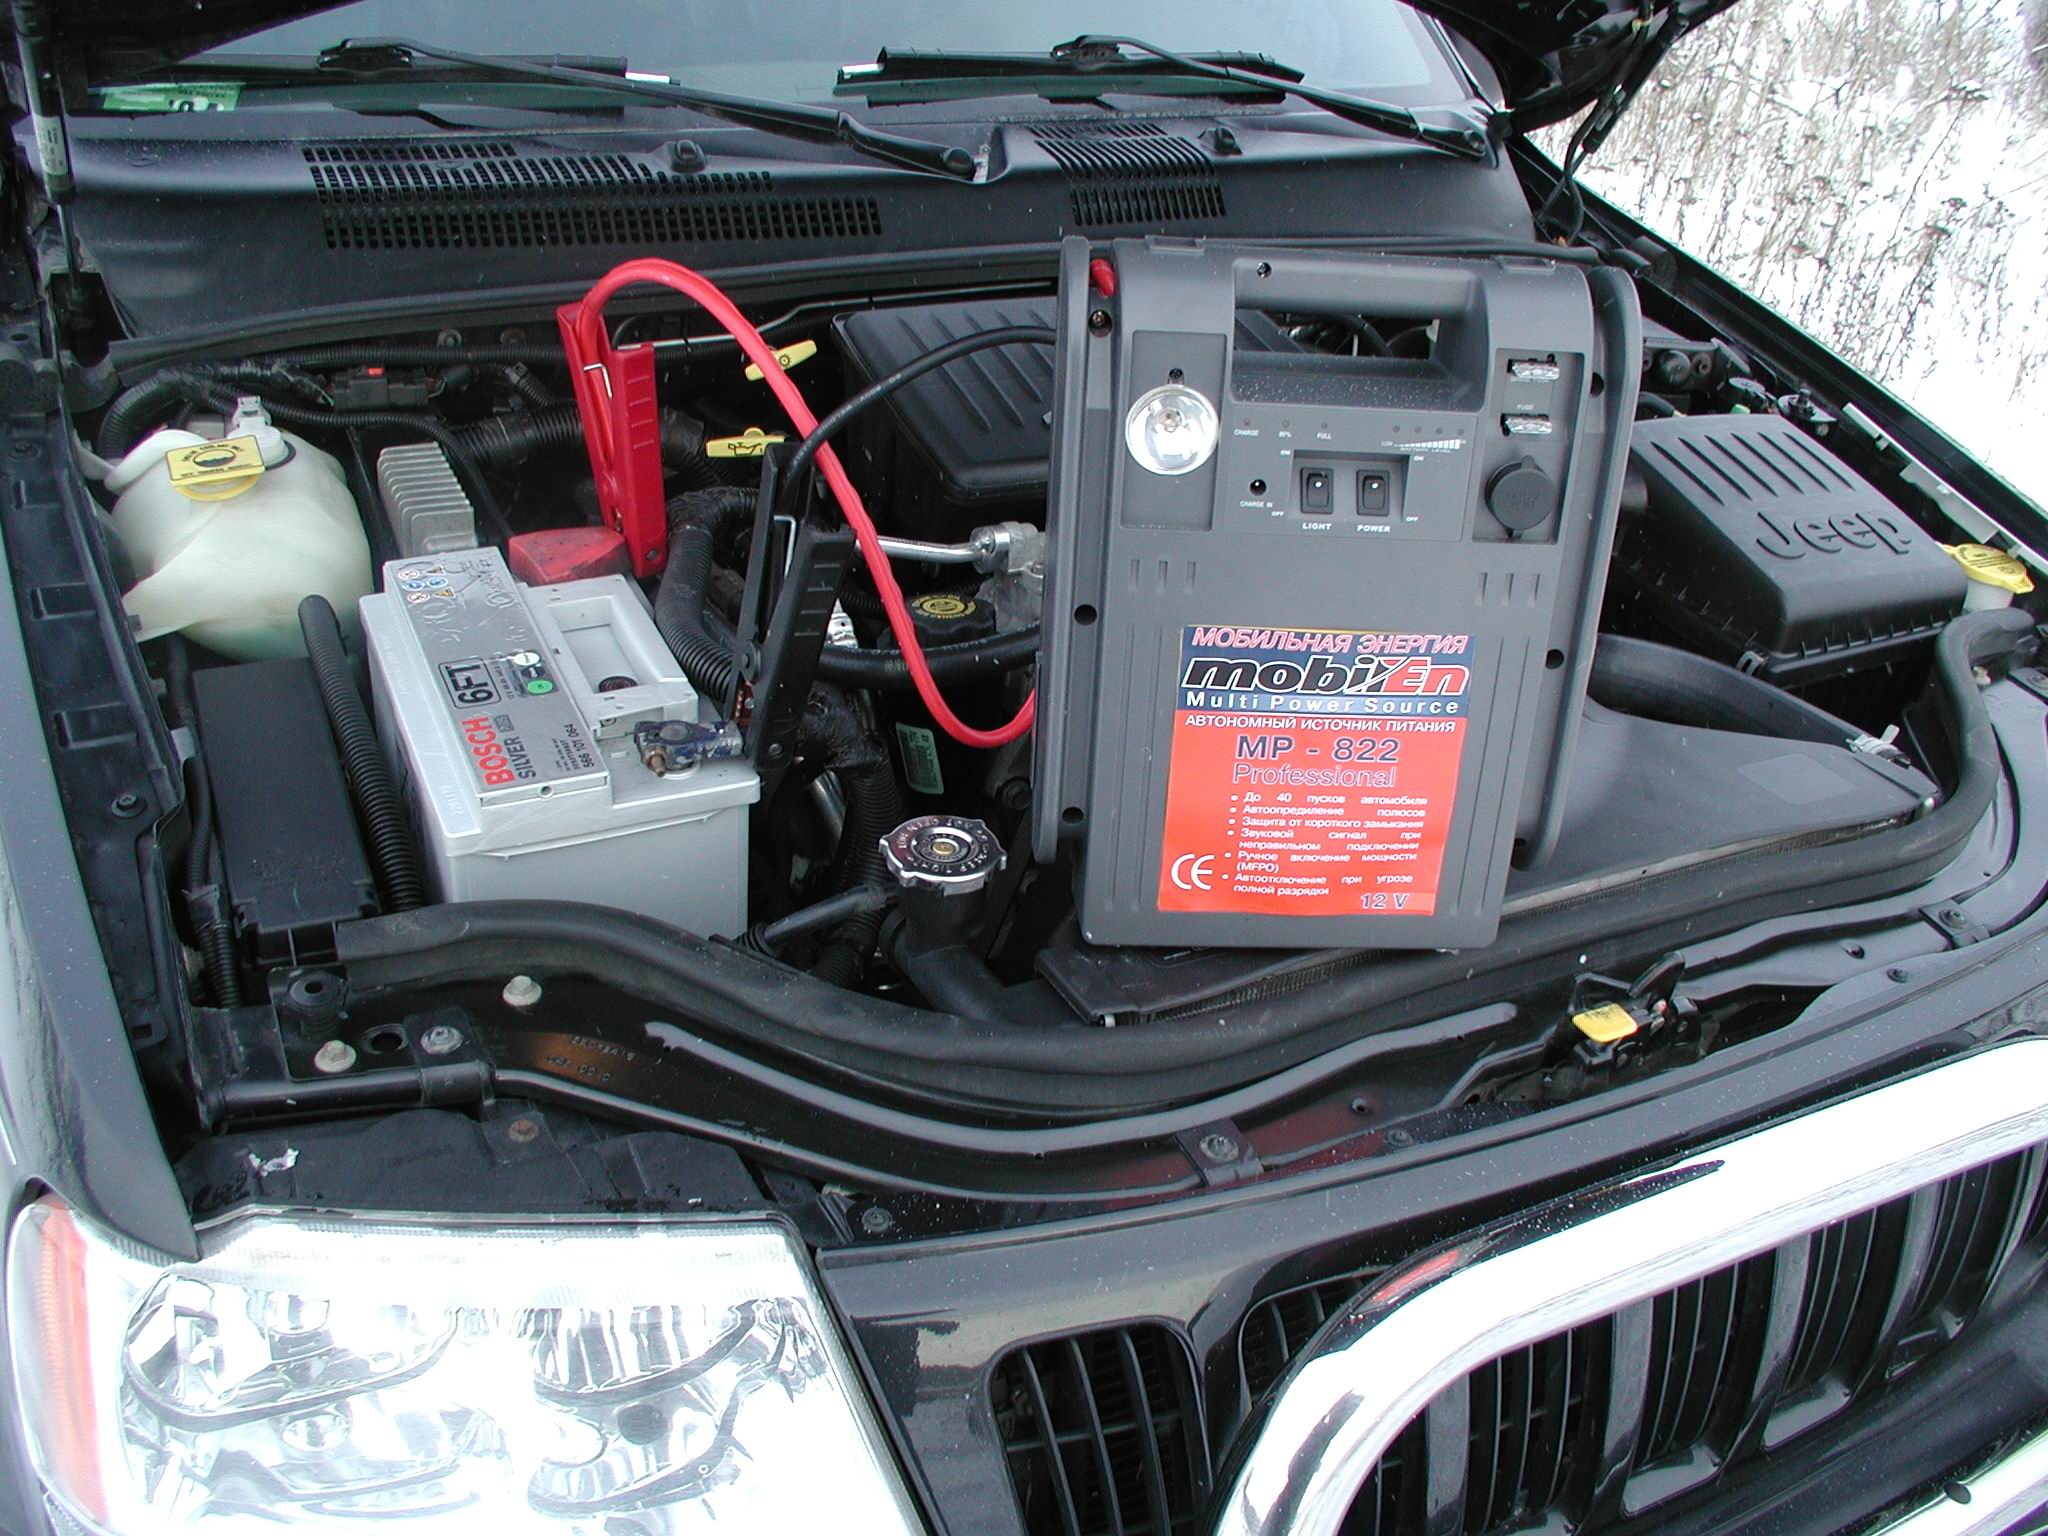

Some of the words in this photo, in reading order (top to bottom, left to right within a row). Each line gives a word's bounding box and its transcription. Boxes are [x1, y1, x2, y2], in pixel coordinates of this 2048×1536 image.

[1316, 432, 1332, 440] FULL
[1302, 522, 1332, 530] LIGHT
[1357, 524, 1391, 533] POWER
[1755, 510, 1913, 561] Jeep
[1191, 627, 1353, 654] МОБИЛЬНАЯ
[1356, 634, 1469, 654] ЭНЕРГИЯ
[1186, 692, 1258, 709] Multi
[1270, 695, 1352, 712] Power
[1364, 699, 1459, 714] Source
[1185, 715, 1297, 730] АВТОНОМНЫЙ
[1300, 718, 1382, 732] ИСТОЧНИК
[1386, 720, 1456, 733] ПИТАНИЯ
[460, 716, 516, 785] BOSCH
[1235, 735, 1294, 759] MP
[1332, 736, 1400, 763] 822
[504, 736, 536, 779] SILVER
[1232, 762, 1397, 788] Professional
[1243, 791, 1262, 803] До
[1276, 792, 1292, 802] 40
[1306, 794, 1346, 805] пусков
[1360, 795, 1428, 805] автомобиля
[1376, 808, 1426, 818] полюсов
[1241, 816, 1286, 827] Защита
[1304, 819, 1361, 828] короткого
[1363, 820, 1424, 828] замыкания
[1240, 828, 1294, 839] Звуковой
[1328, 831, 1367, 840] сигнал
[1400, 831, 1421, 841] при
[1239, 841, 1321, 851] неправильном
[1346, 842, 1419, 852] подключении
[1237, 850, 1279, 861] Ручное
[1290, 853, 1350, 862] включение
[1361, 852, 1417, 862] мощности
[1236, 862, 1279, 873] (MFPO)
[1234, 872, 1327, 884] Автоотключение
[1341, 875, 1363, 885] при
[1376, 875, 1414, 884] угрозе
[1233, 884, 1275, 894] полной
[1277, 886, 1329, 897] разрядки
[1361, 893, 1387, 909] 12
[1393, 893, 1410, 909] V
